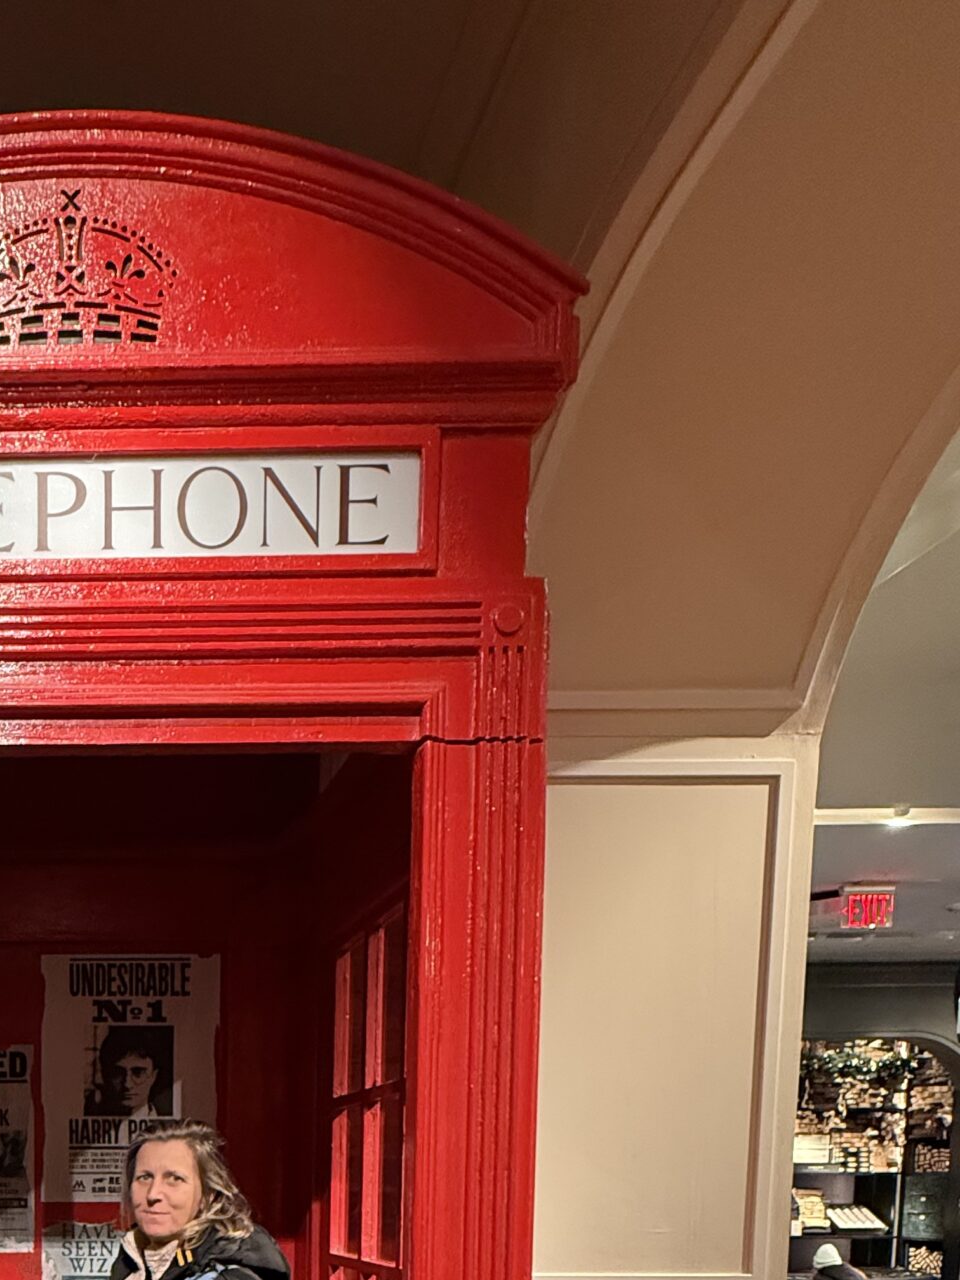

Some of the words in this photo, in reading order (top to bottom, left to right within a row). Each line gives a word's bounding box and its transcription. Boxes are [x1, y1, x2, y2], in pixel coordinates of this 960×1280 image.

[848, 894, 890, 927] EXIT
[69, 962, 191, 997] UNDESIRABLE
[69, 1119, 120, 1144] HARRY
[62, 1223, 117, 1239] HAVE
[62, 1241, 114, 1257] SEEN
[69, 1257, 108, 1273] WIZ
